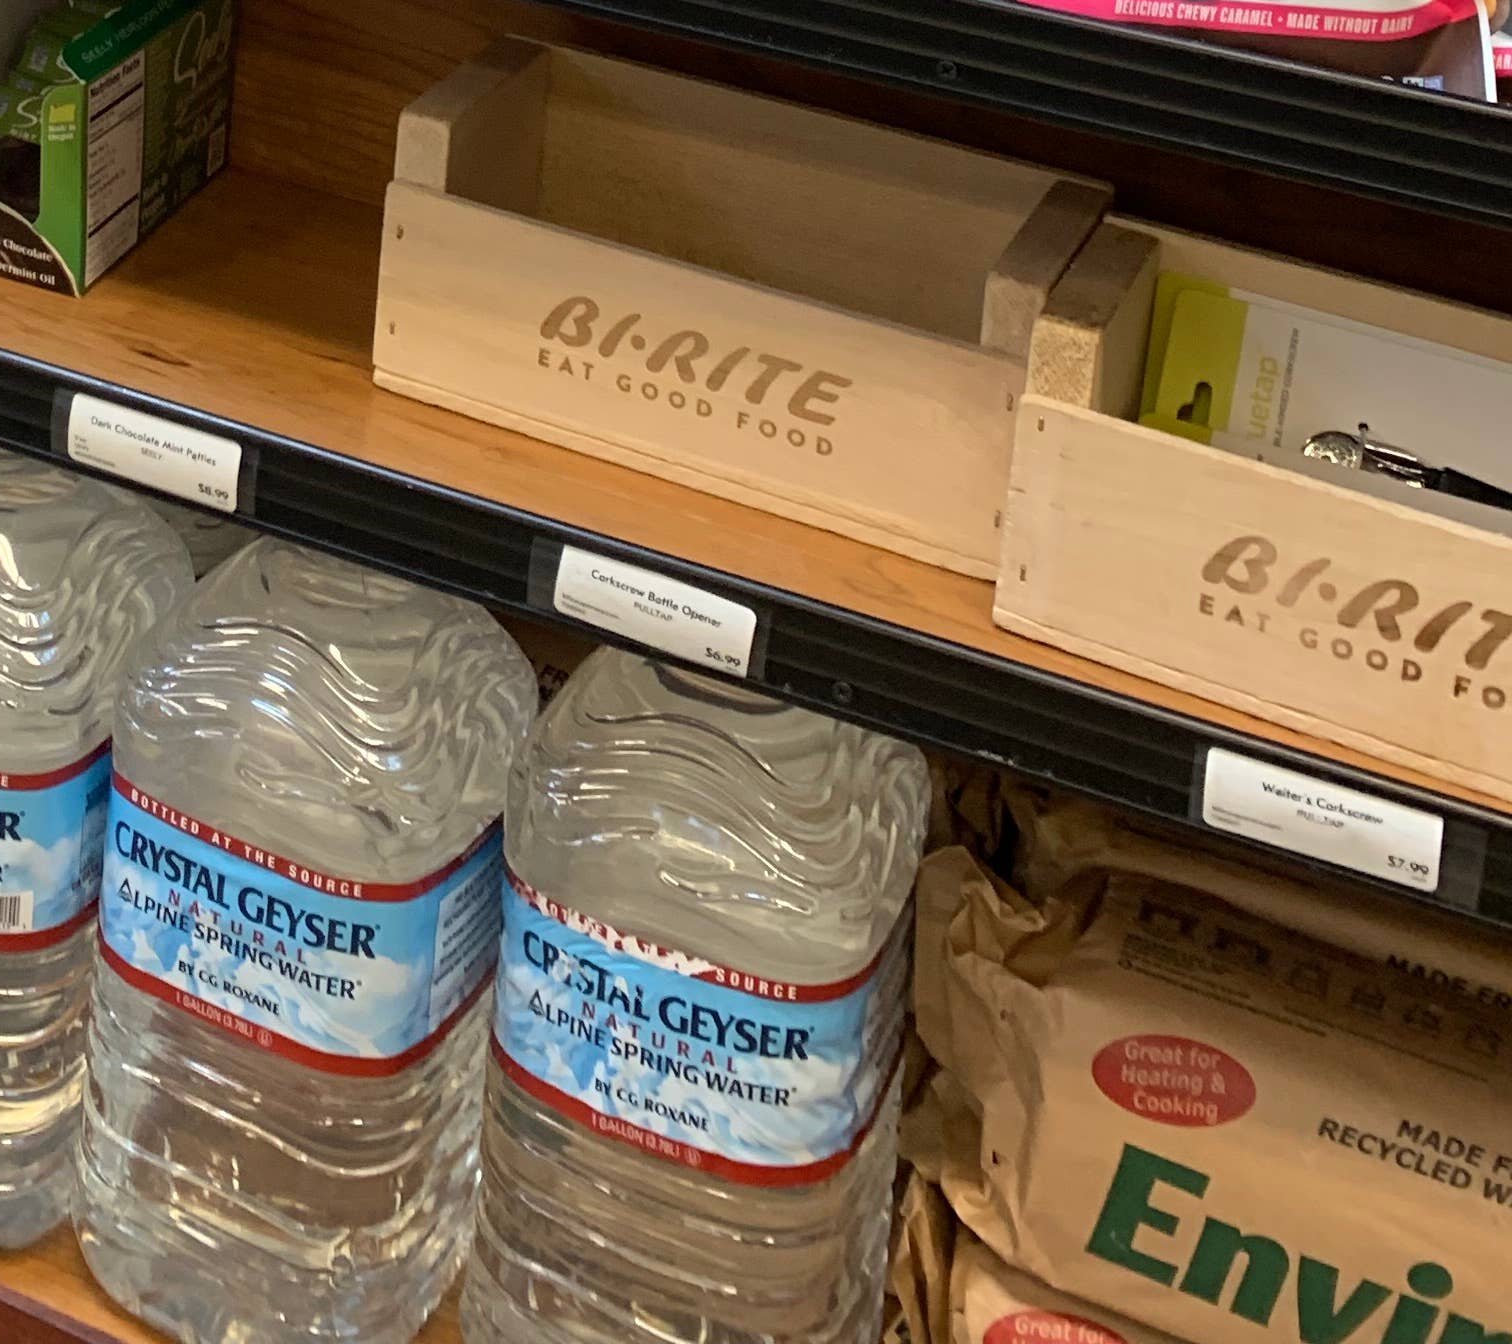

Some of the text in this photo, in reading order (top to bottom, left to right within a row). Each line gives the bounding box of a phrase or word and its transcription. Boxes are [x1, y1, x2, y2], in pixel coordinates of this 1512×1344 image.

[1178, 3, 1217, 25] CHEWY
[1219, 5, 1273, 27] CARAMEL
[1286, 12, 1321, 32] MADE
[1323, 12, 1379, 34] WITHOUT
[1381, 14, 1414, 35] DAIRY
[3, 236, 53, 264] Chocolate
[39, 270, 56, 286] Oil
[537, 347, 834, 458] EAT GOOD FOOD
[90, 415, 217, 468] Dark Chocolate Mint Patties
[590, 569, 723, 629] Corkscrew Bottle Opener
[704, 646, 742, 668] $6.99
[1198, 592, 1269, 634] EAT
[1300, 628, 1423, 684] GOOD
[1261, 779, 1385, 826] Waiter's Corkscrew
[114, 819, 231, 911] CRYSTAL
[237, 885, 377, 959] GEYSER
[118, 878, 357, 1001] ALPINE SPRING WATER
[522, 930, 652, 1023] CRYSTAL
[658, 997, 809, 1061] GEYSER
[715, 967, 798, 1002] SOURCE
[1123, 1040, 1221, 1069] Great for
[644, 1098, 709, 1132] ROXANE
[1132, 1090, 1219, 1127] Cooking
[1318, 1118, 1472, 1192] RECYCLED
[1397, 1118, 1487, 1167] MADE
